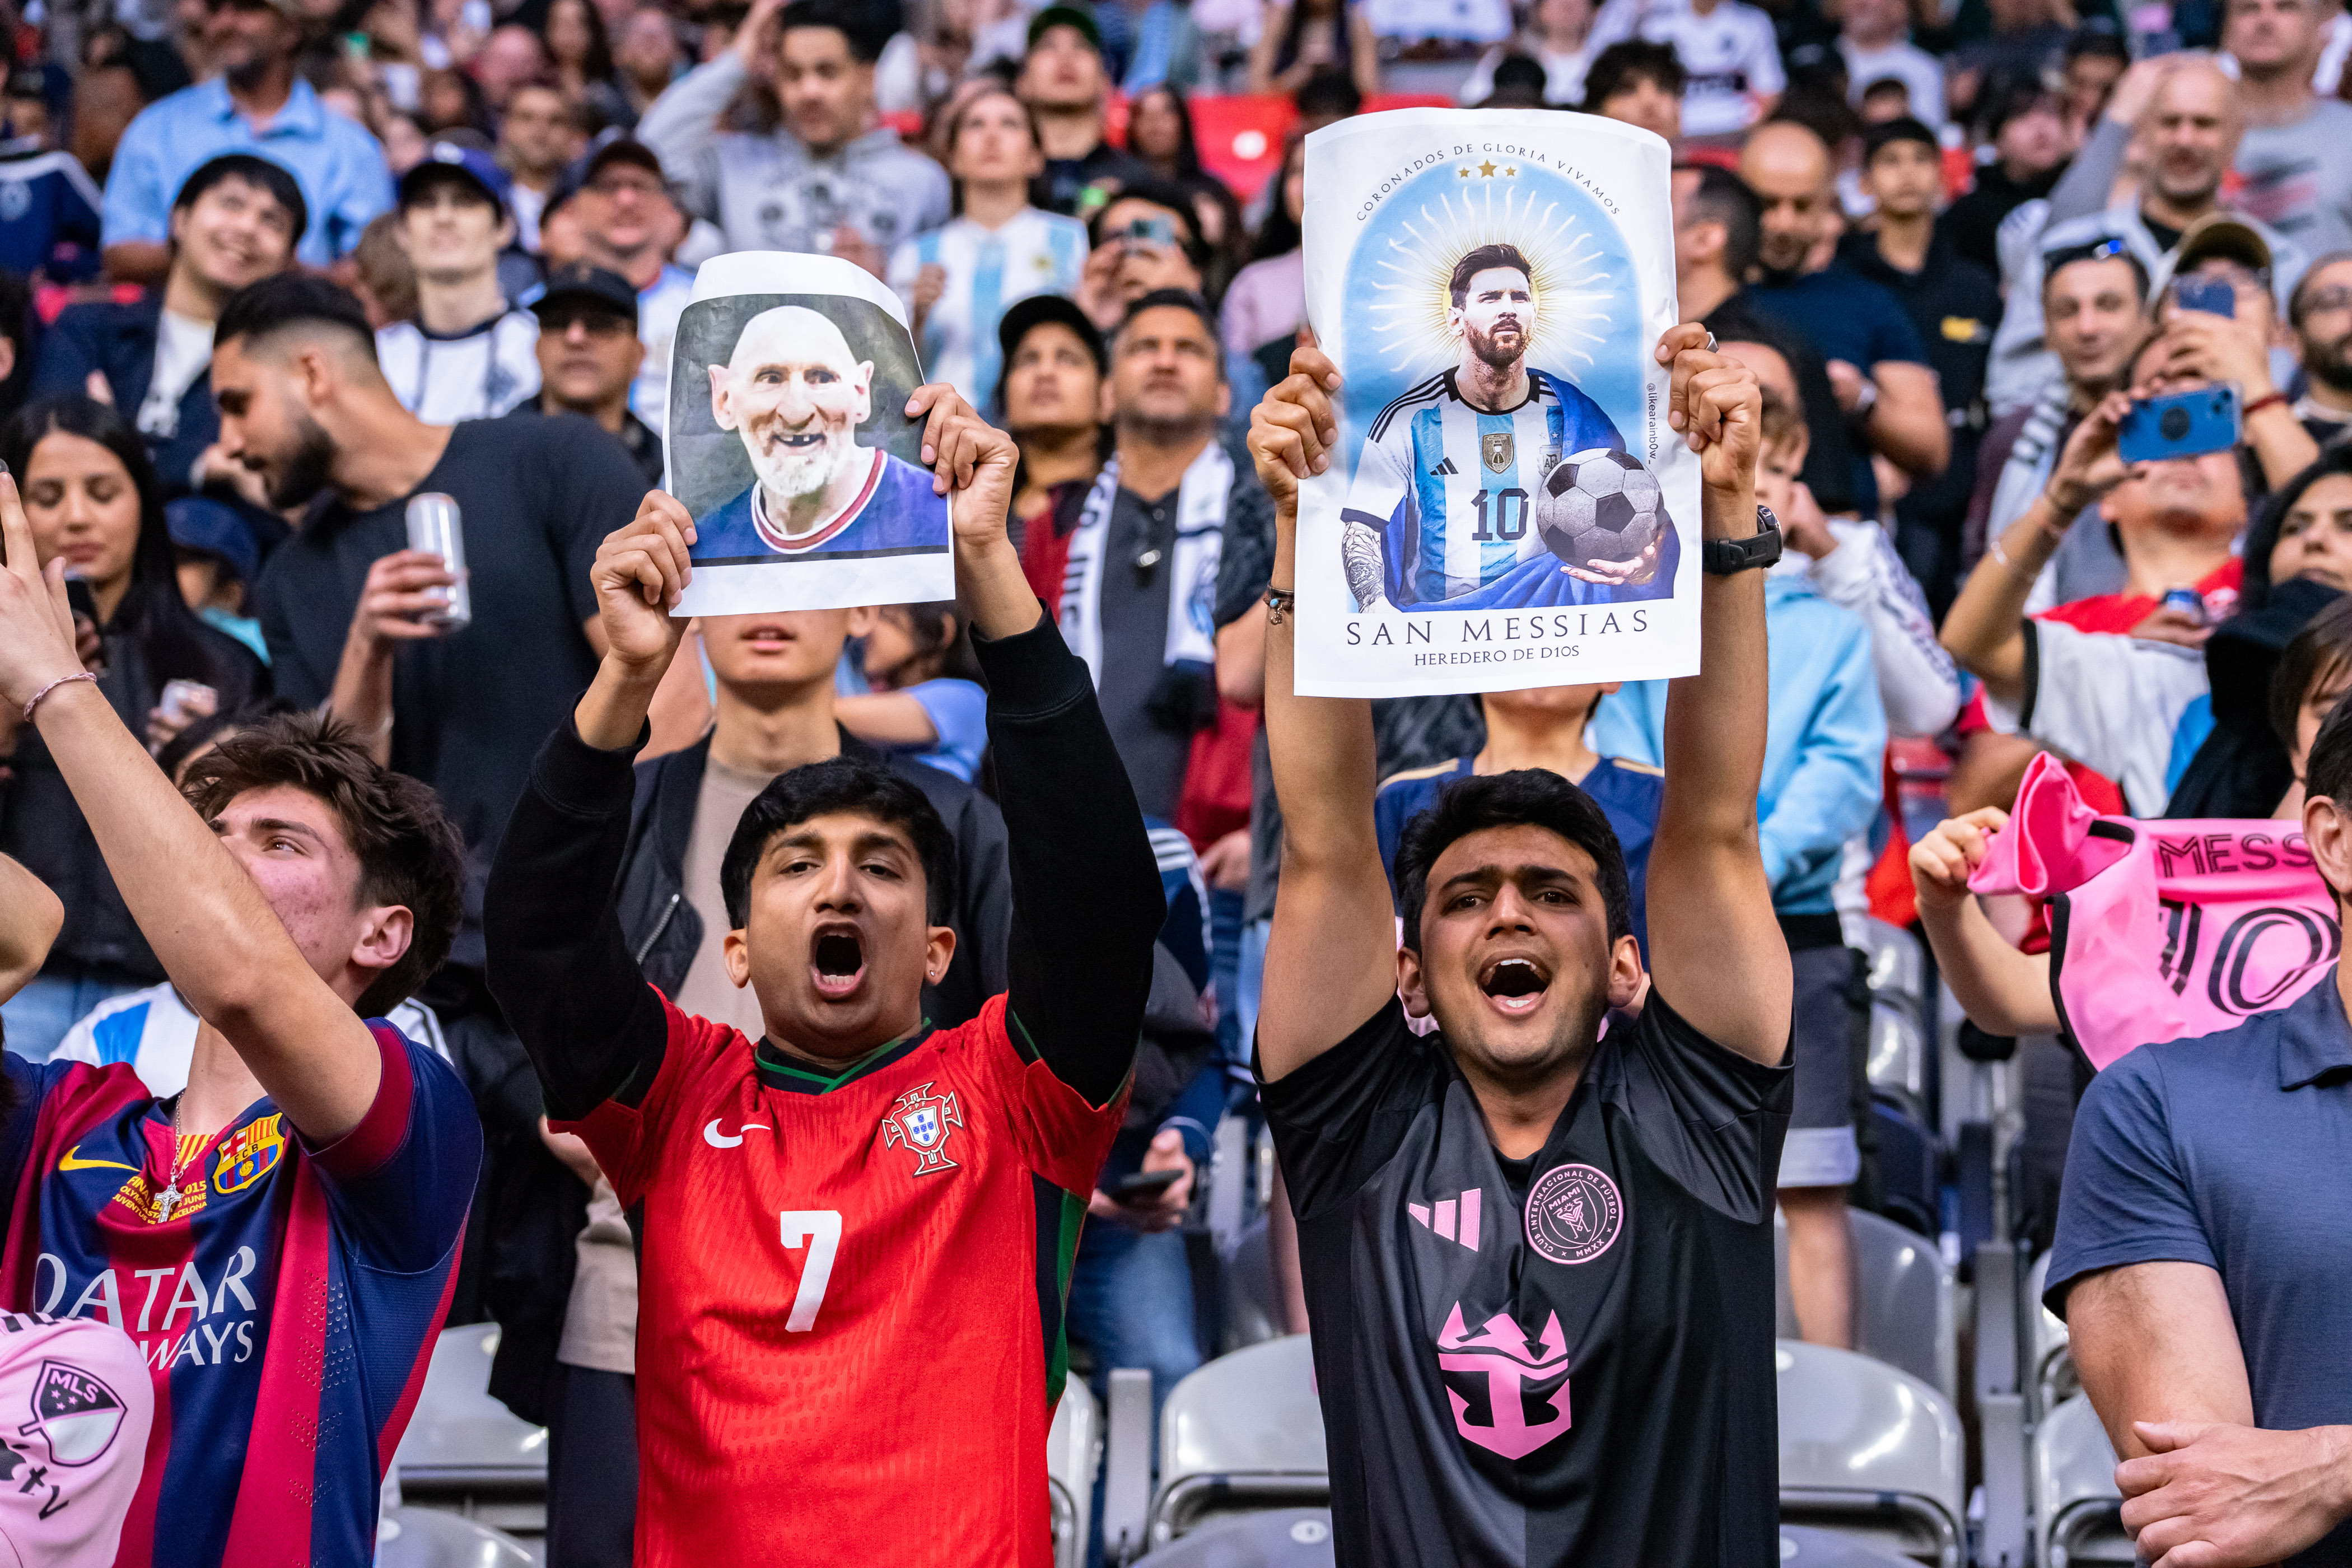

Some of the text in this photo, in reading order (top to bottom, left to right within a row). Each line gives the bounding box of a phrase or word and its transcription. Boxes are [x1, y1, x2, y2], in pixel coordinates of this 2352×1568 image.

[1356, 143, 1620, 221] CORONADOS DE GLORIA VIVAMOS
[1470, 488, 1529, 541] 10
[1346, 609, 1648, 645] SAN MESSIAS
[1414, 650, 1506, 666] HEREDERO
[1512, 648, 1534, 661] DE
[2158, 832, 2317, 878] MESS
[234, 1143, 259, 1164] FCB
[112, 1193, 148, 1221] JUVENTUS
[170, 1201, 208, 1221] ARCELONA
[119, 1185, 160, 1219] OLYMPIAST
[184, 1192, 207, 1206] JUNE
[127, 1175, 207, 1206] FINAL 015
[1548, 1186, 1581, 1210] MIAMI
[1530, 1170, 1617, 1252] CLUB INTERNACIONAL DE FÚTBOL
[1575, 1238, 1605, 1257] MMXX
[780, 1210, 842, 1333] 7
[139, 1320, 254, 1371] WAYS
[49, 1370, 99, 1404] MLS
